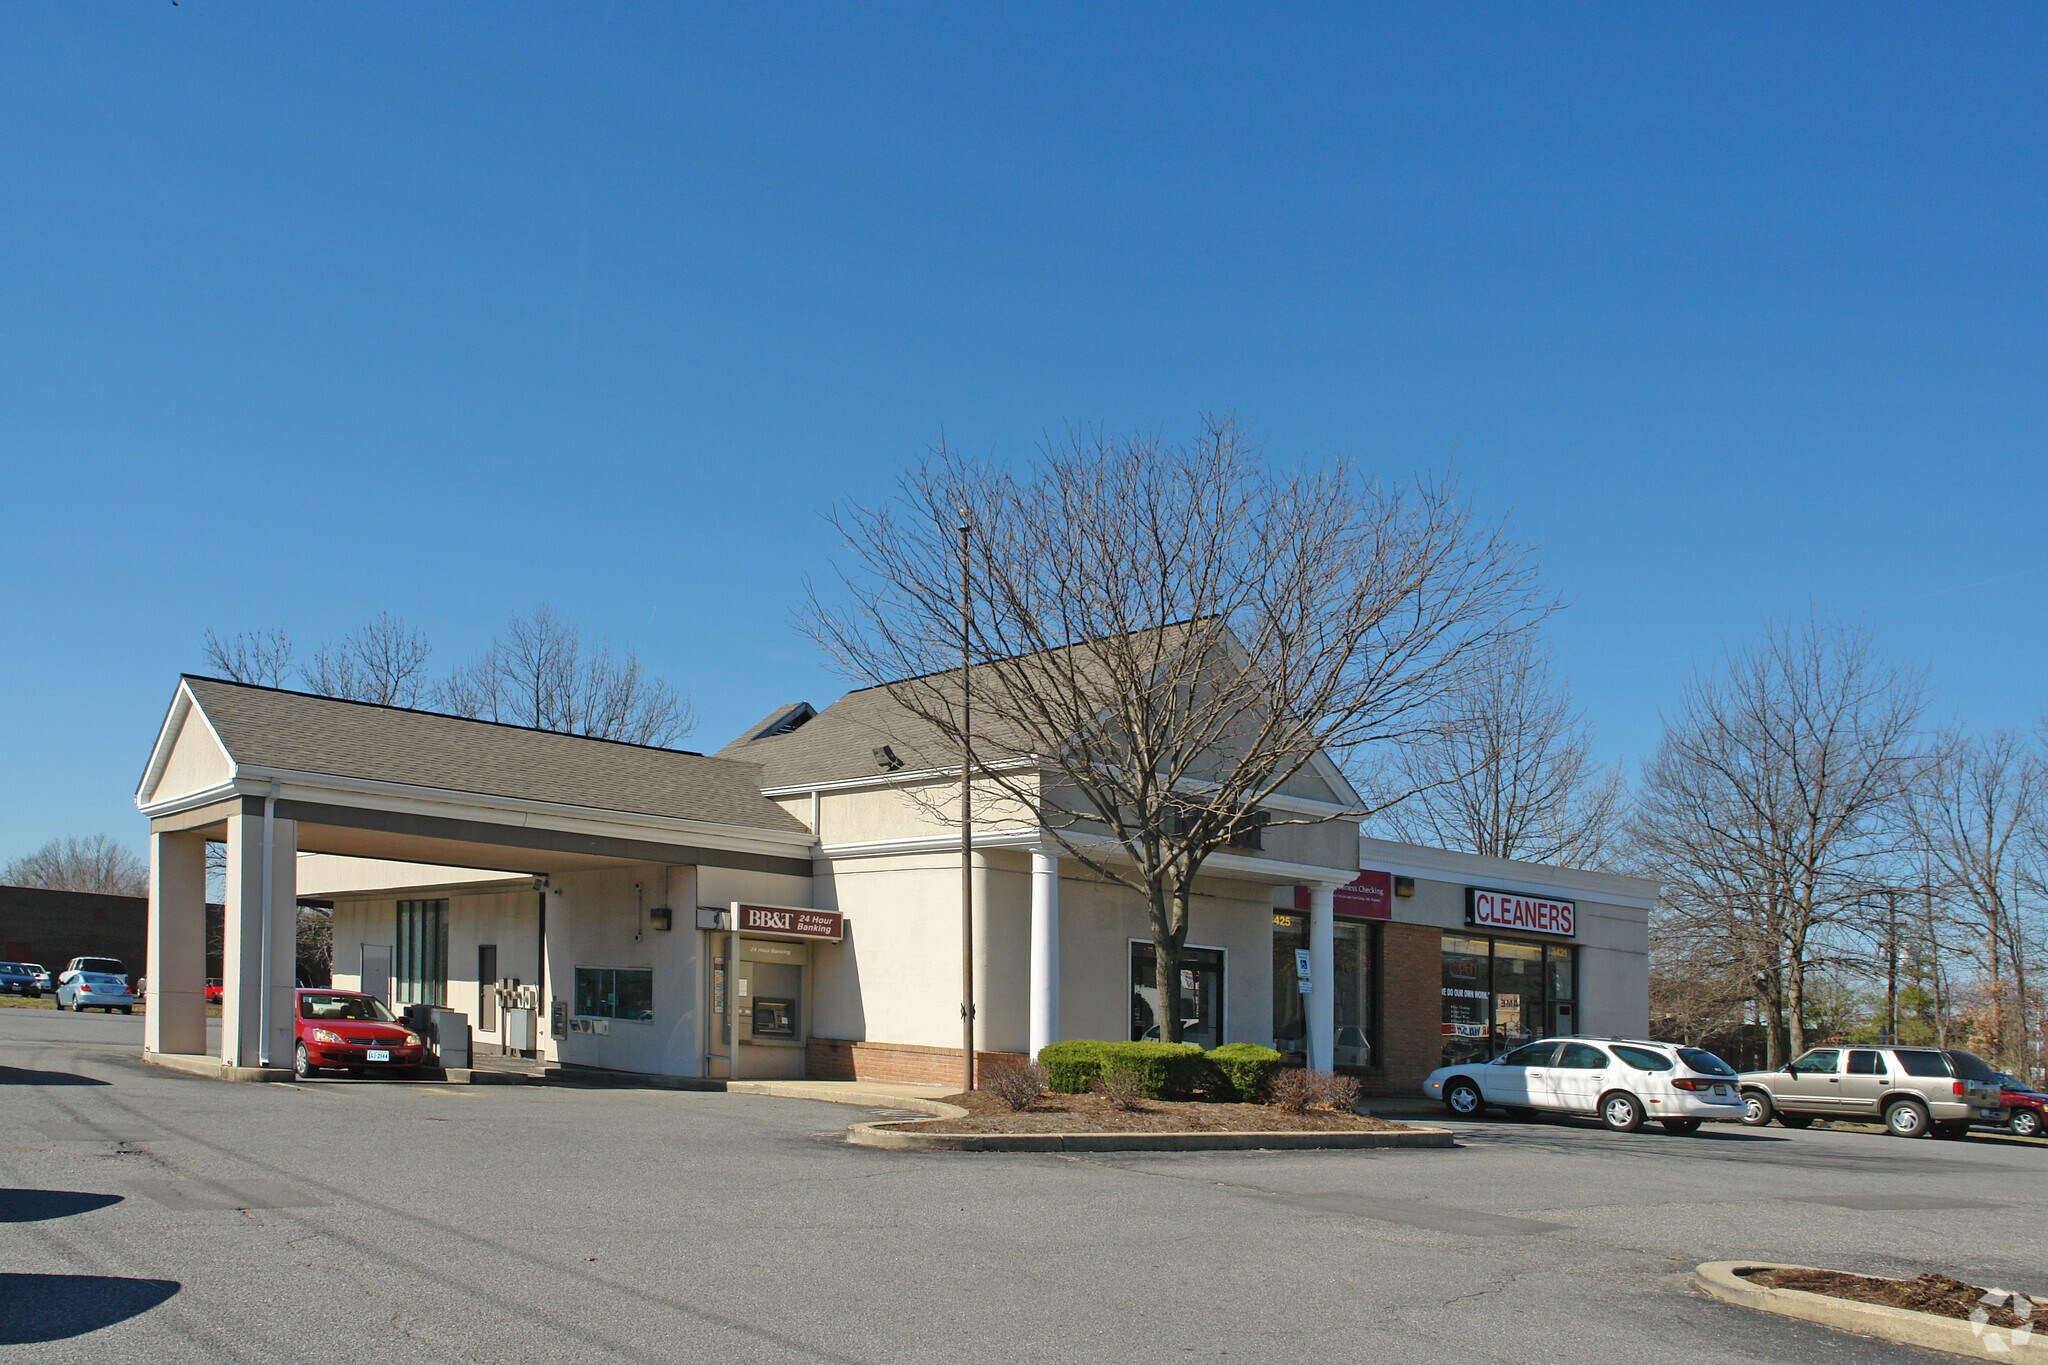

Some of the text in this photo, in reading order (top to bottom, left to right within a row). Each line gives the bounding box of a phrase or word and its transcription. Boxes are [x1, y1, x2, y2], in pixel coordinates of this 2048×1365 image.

[1358, 885, 1384, 896] Checking
[748, 909, 795, 929] BB&T
[799, 914, 833, 924] 24 Hour
[1476, 894, 1572, 933] CLEANERS
[1272, 915, 1290, 926] 425
[797, 923, 831, 934] Banking
[770, 948, 791, 956] Banking
